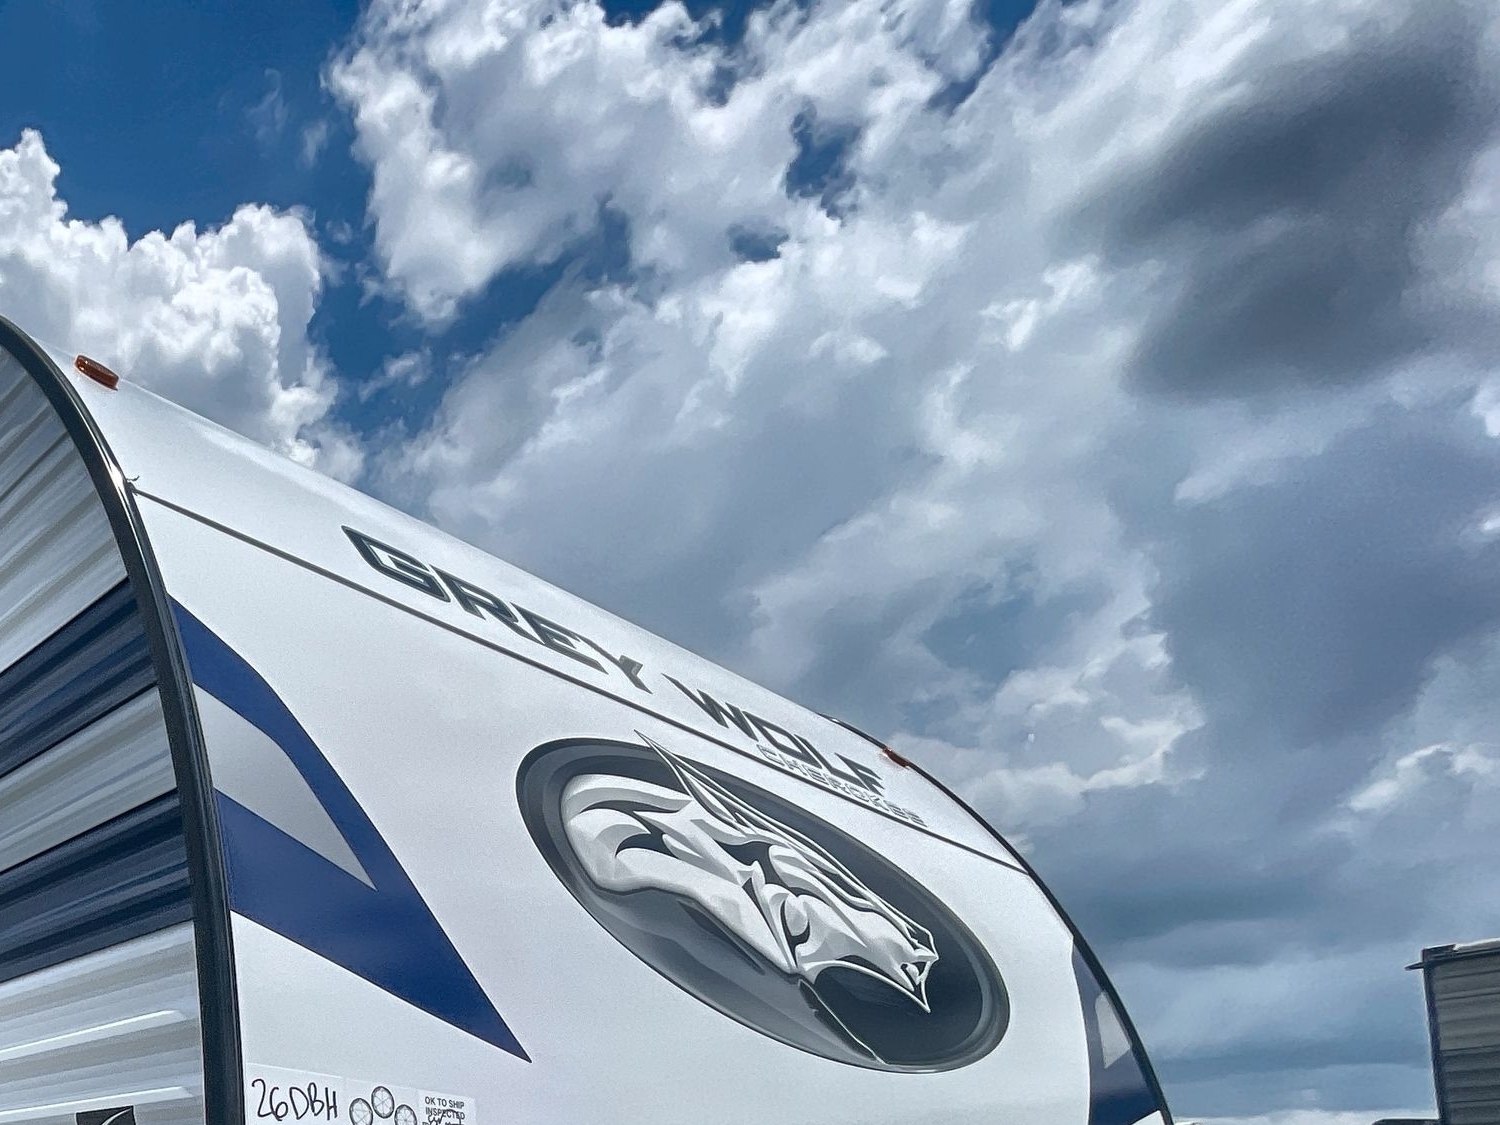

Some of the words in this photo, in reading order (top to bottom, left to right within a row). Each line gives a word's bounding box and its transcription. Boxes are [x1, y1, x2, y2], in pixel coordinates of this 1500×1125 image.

[341, 525, 653, 695] GREY
[661, 672, 885, 798] WOLF
[756, 744, 928, 828] CHEROKEE
[251, 1078, 338, 1122] 26DBH
[424, 1096, 436, 1106] OK
[437, 1098, 447, 1107] TO
[448, 1099, 465, 1109] SHIP
[425, 1106, 466, 1120] INSPECTED
